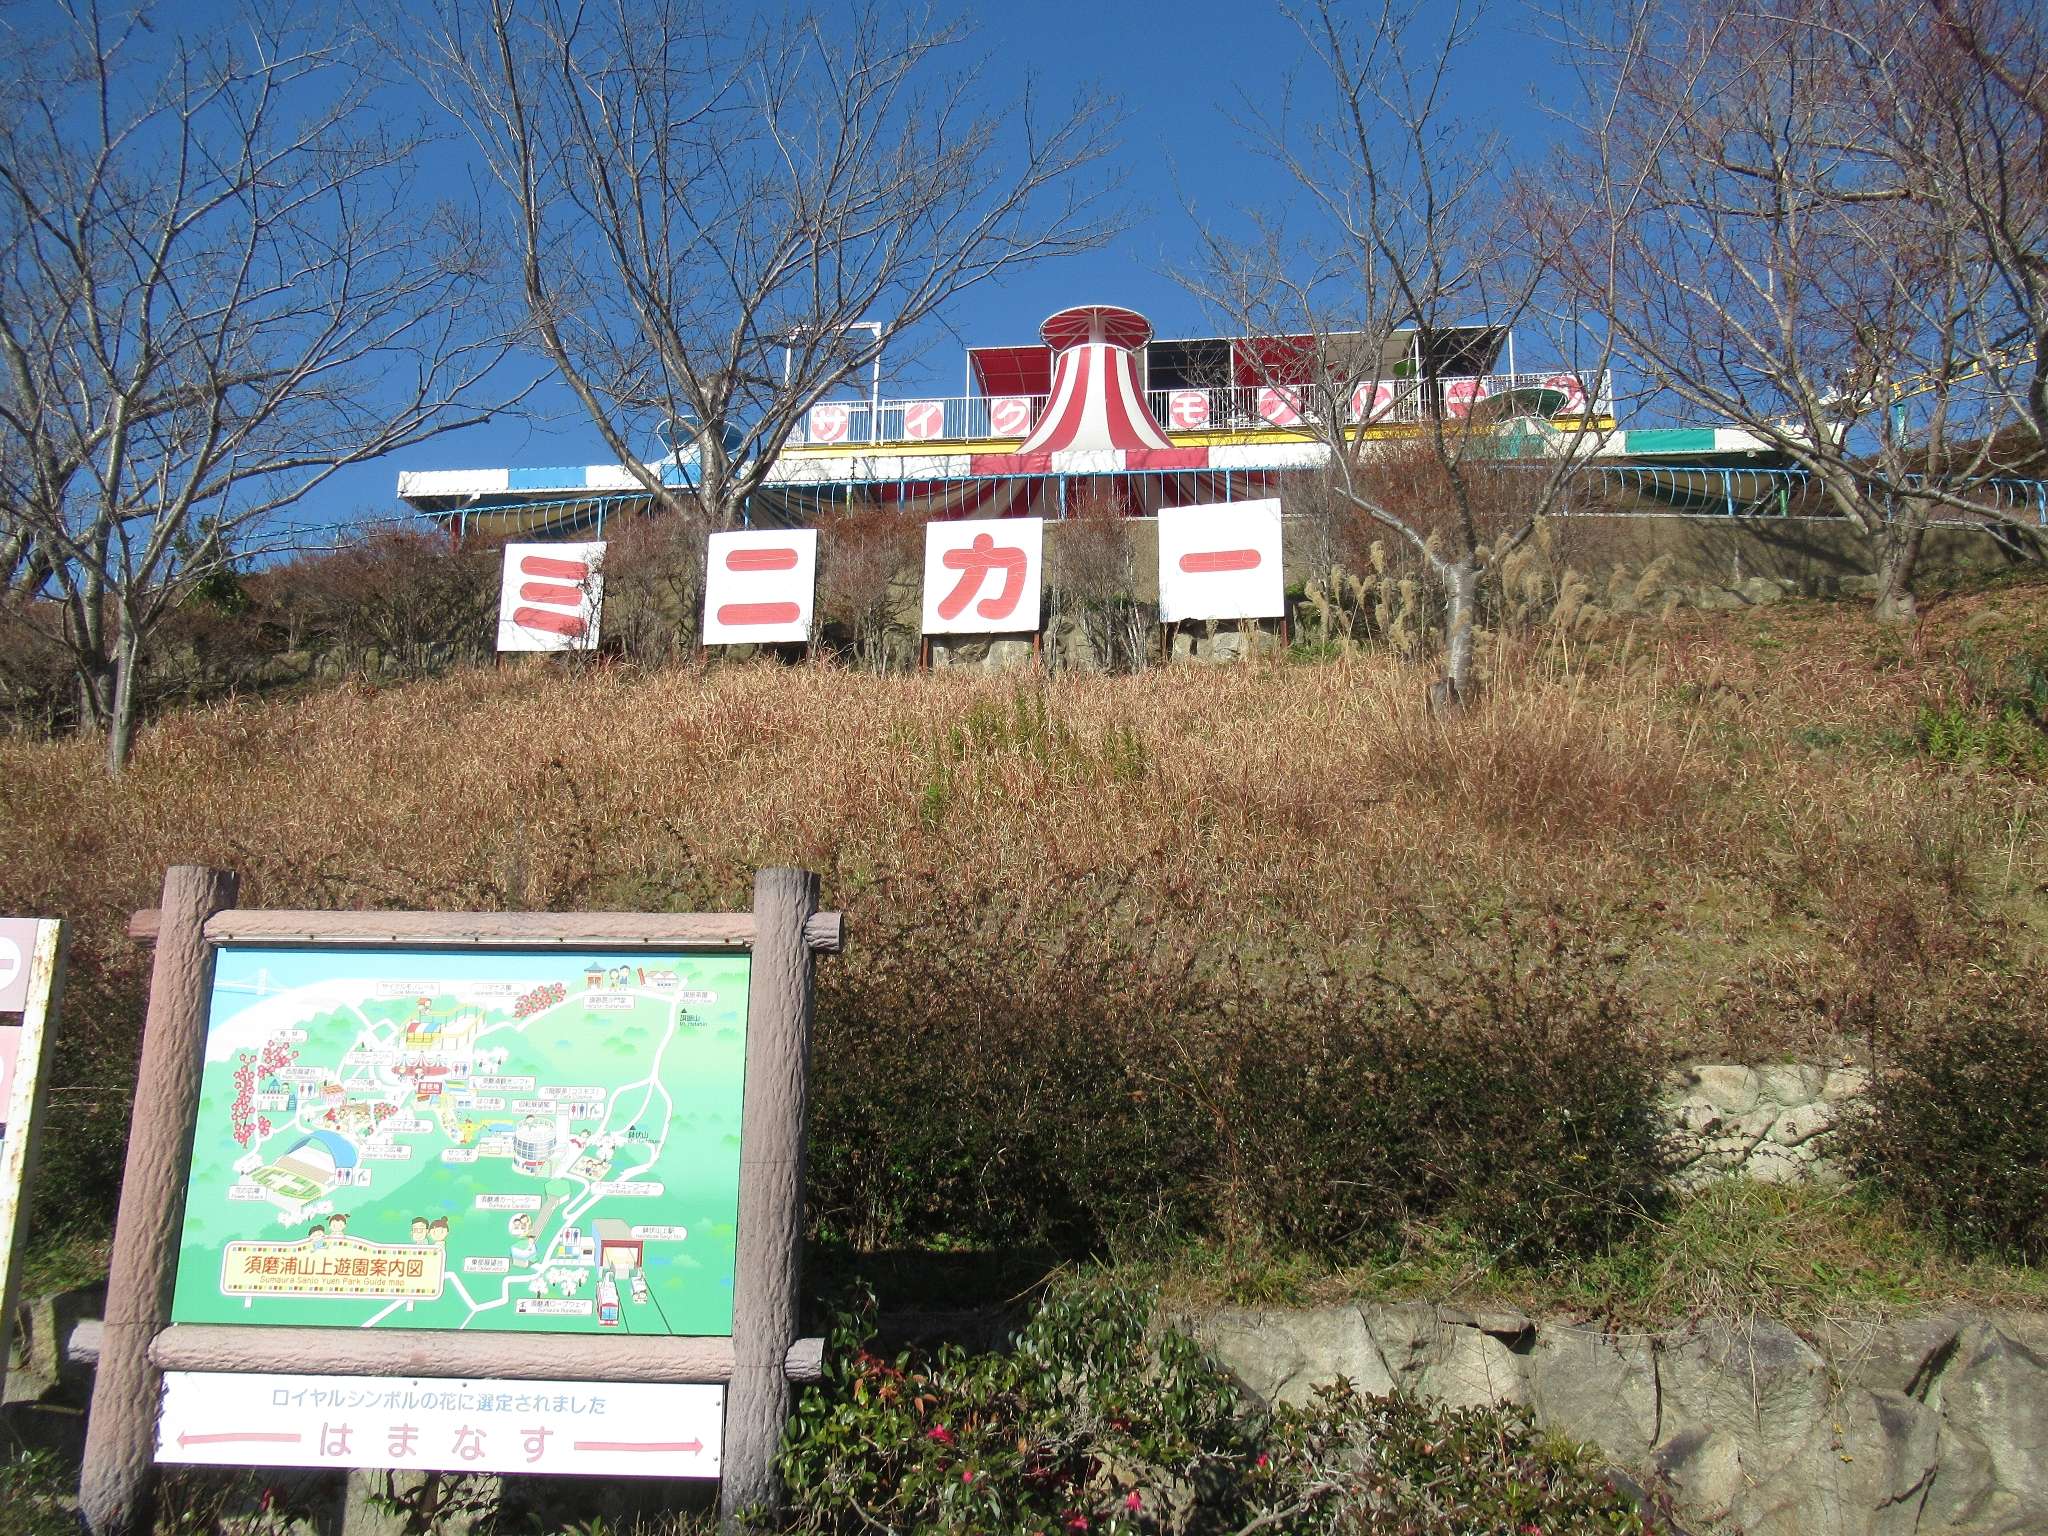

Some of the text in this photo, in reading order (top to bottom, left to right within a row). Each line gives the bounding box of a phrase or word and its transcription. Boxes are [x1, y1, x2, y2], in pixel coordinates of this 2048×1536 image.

[244, 1255, 424, 1278] 須磨浦山上遊園案内図
[342, 1277, 361, 1286] Park
[364, 1278, 386, 1286] Guide
[271, 1389, 606, 1415] ロイヤルシンボルの花に選定されました
[319, 1422, 554, 1464] はまなす
